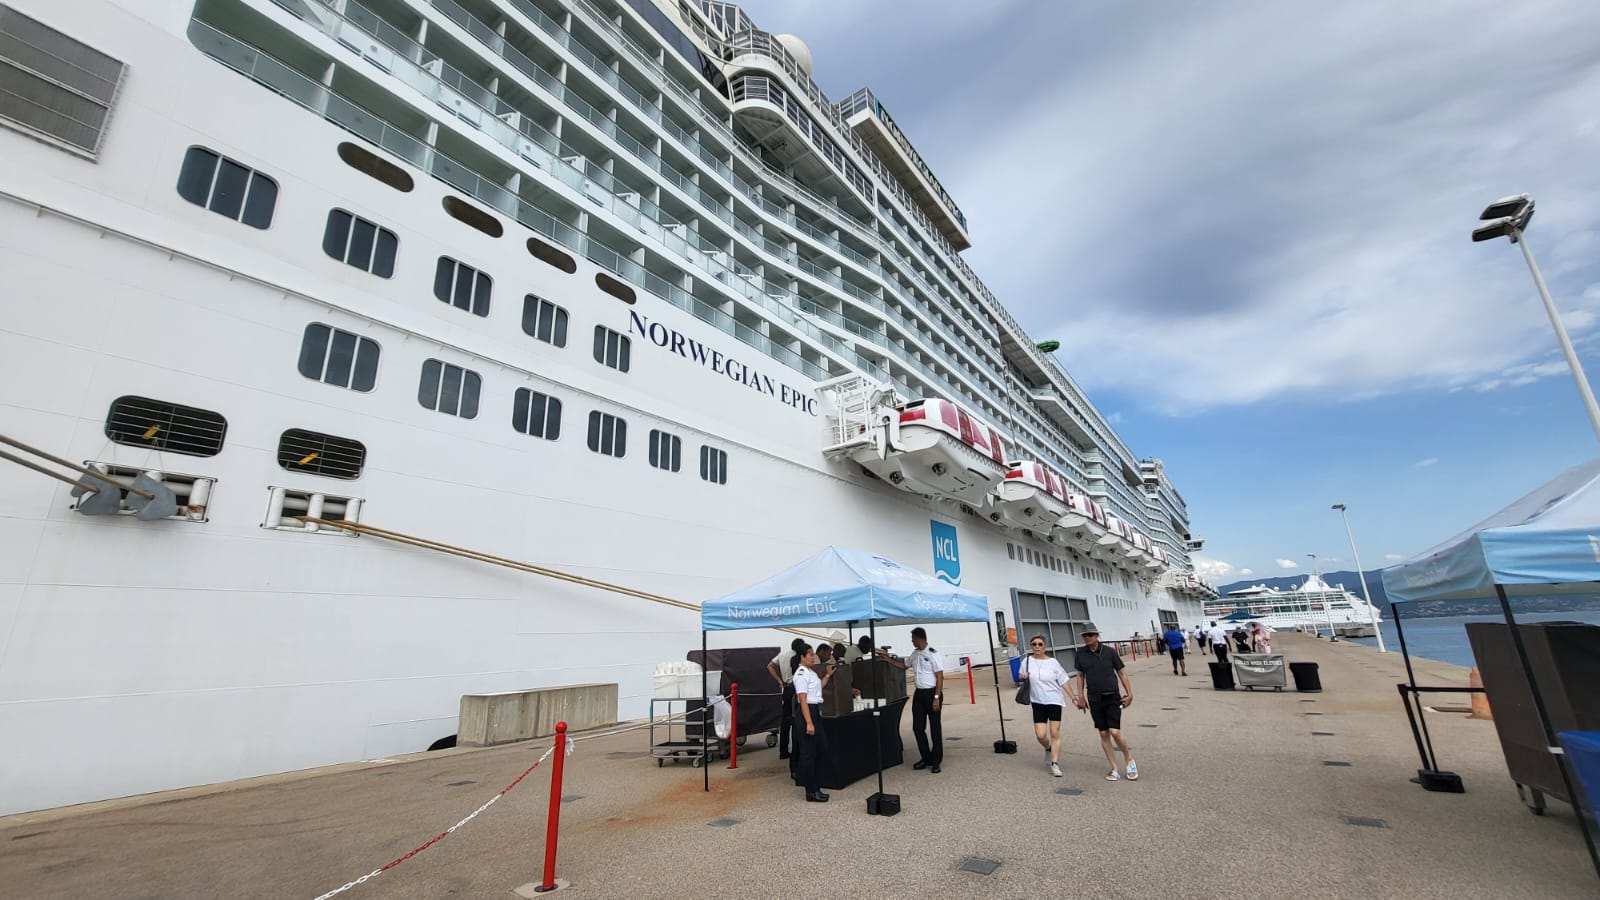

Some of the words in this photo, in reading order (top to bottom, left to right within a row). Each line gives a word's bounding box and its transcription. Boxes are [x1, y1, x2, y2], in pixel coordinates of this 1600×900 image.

[628, 309, 775, 398] NORWEGIAN
[780, 382, 819, 417] EPIC
[935, 535, 957, 562] NCL
[727, 602, 801, 621] Norwegian
[805, 596, 838, 617] Epic
